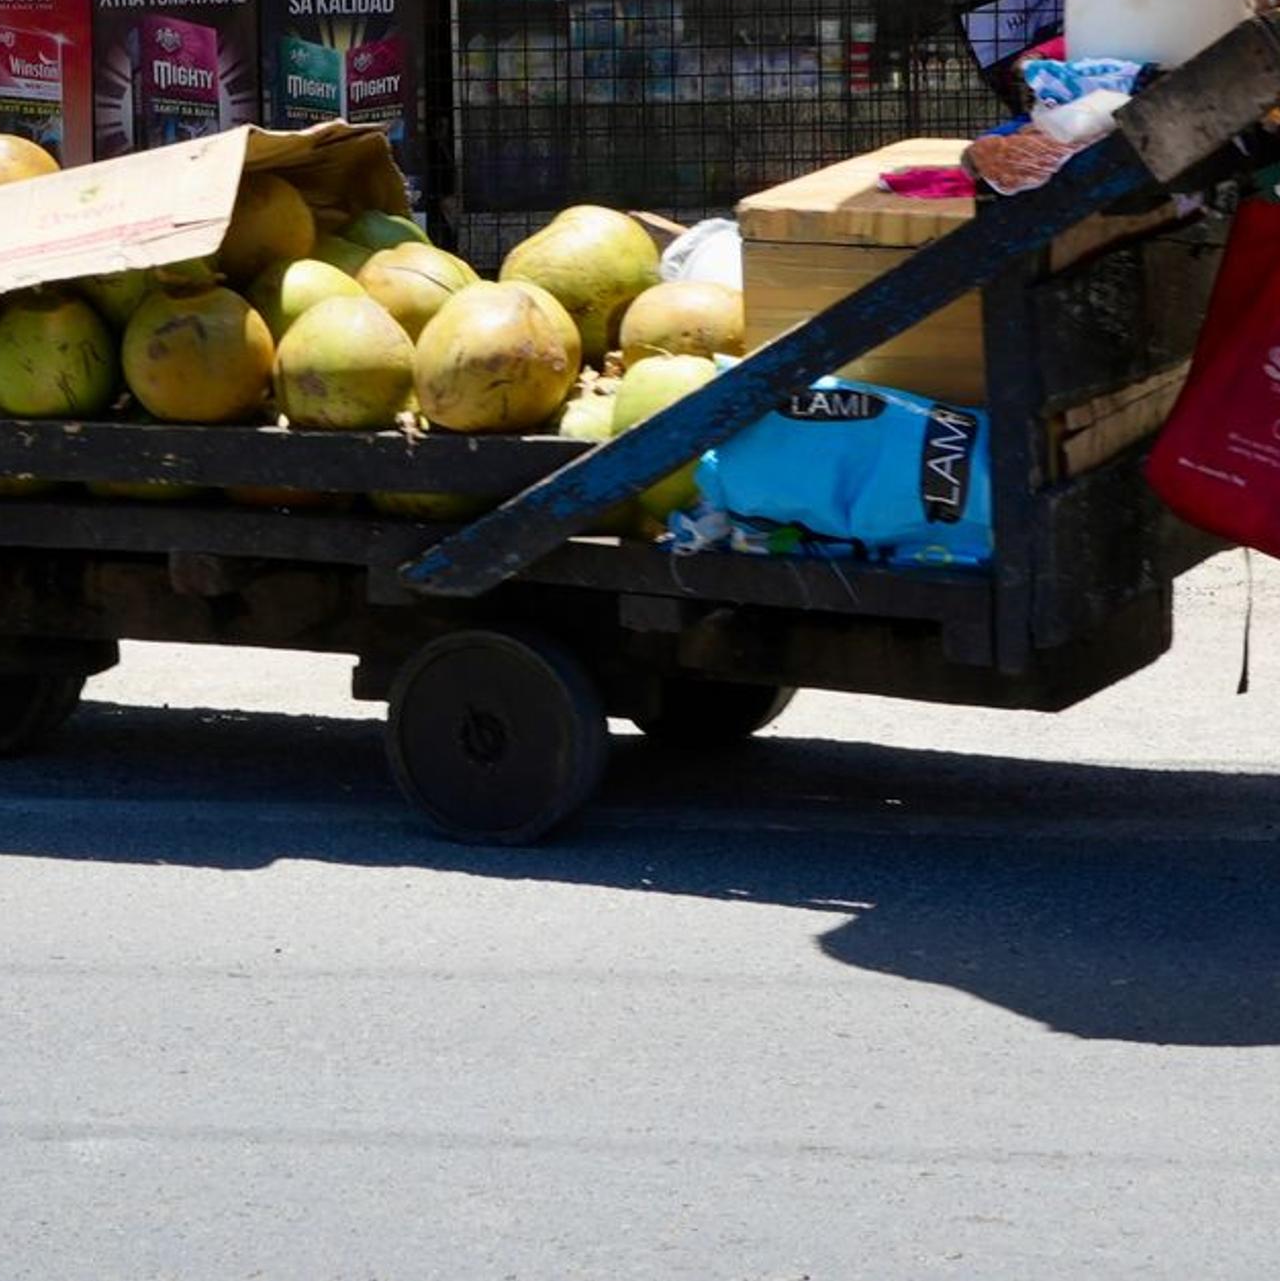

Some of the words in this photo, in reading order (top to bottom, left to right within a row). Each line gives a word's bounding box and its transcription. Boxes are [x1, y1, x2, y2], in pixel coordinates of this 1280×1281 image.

[151, 59, 215, 91] MIGHTY
[286, 74, 338, 100] MIGHTY
[349, 74, 402, 104] MIGHTY
[791, 392, 870, 418] LAMI
